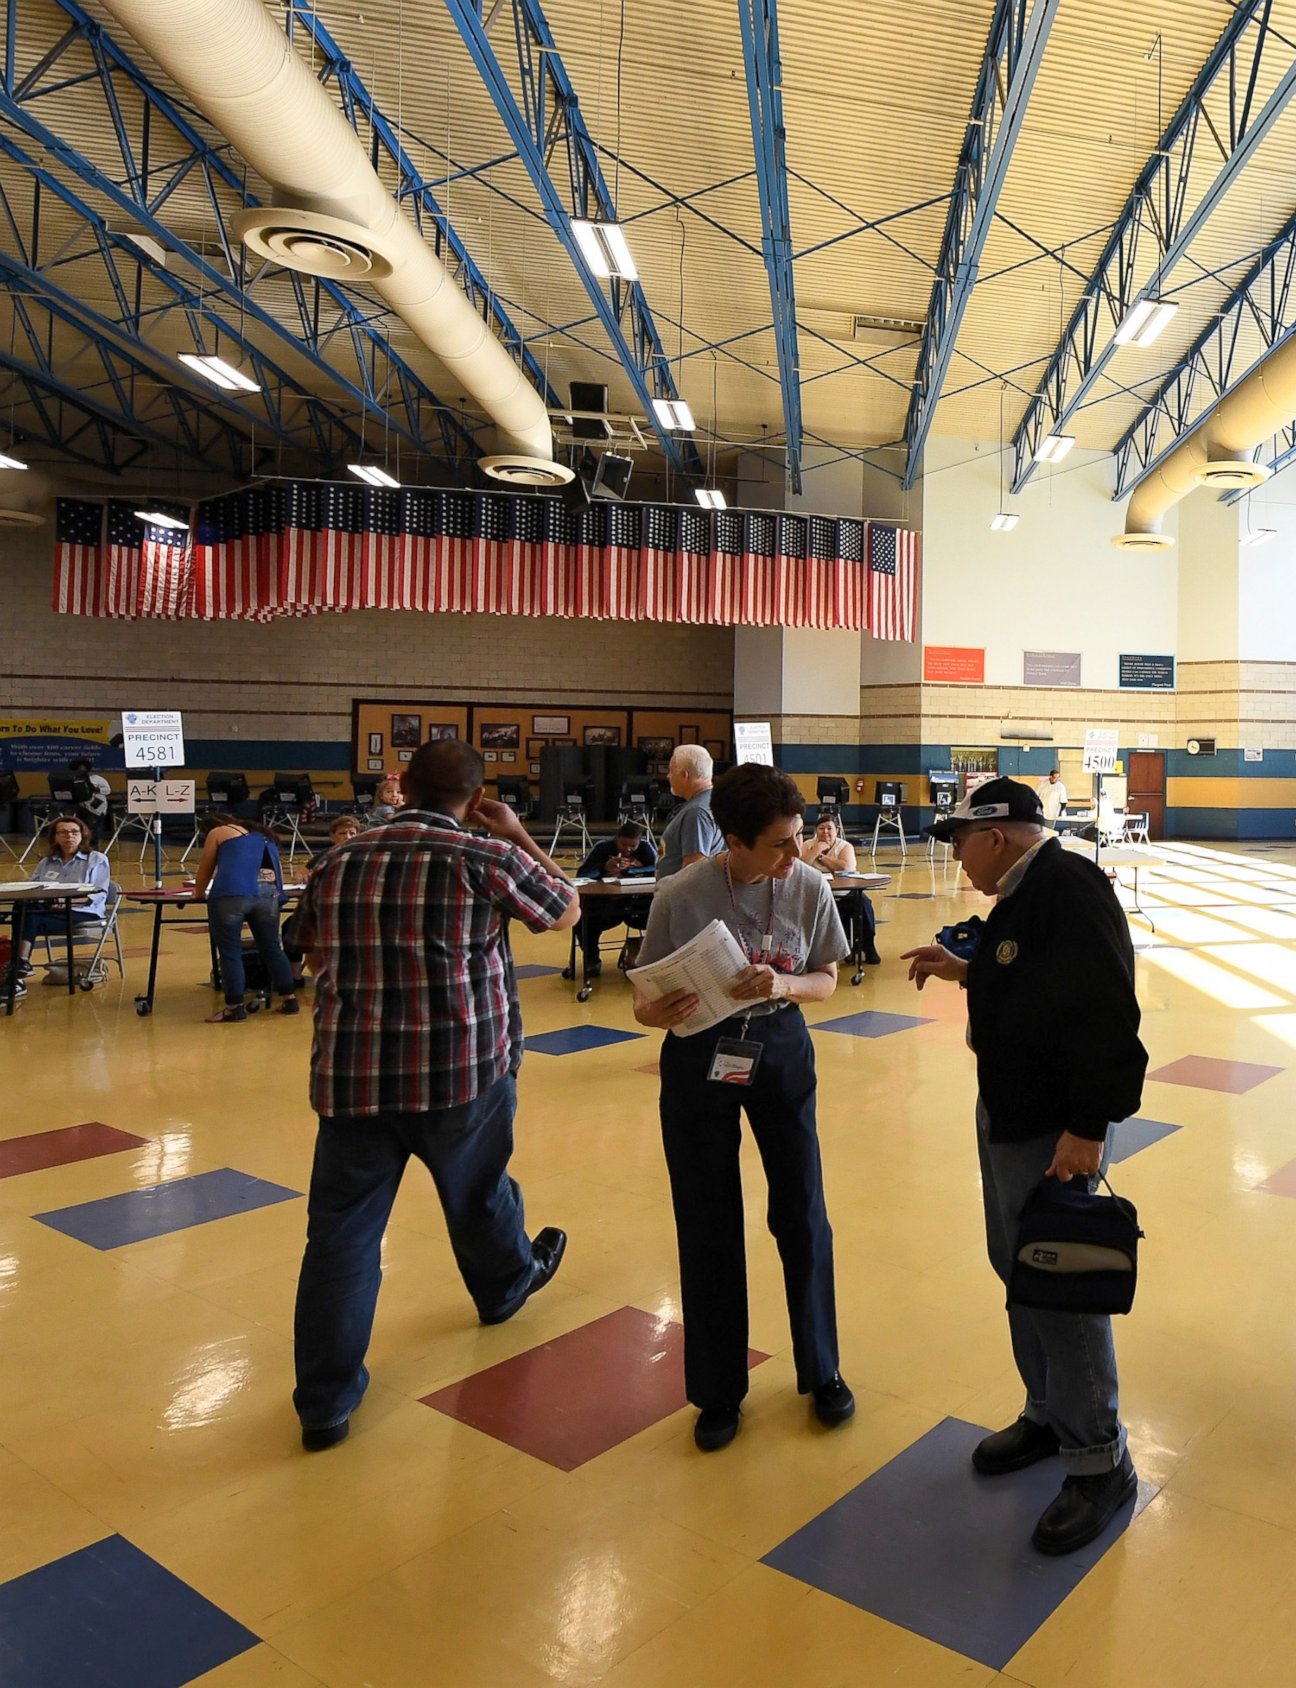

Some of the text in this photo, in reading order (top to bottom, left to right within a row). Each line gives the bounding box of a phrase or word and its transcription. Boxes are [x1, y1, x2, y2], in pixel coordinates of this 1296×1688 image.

[13, 725, 22, 733] To
[26, 725, 37, 733] Do
[39, 725, 60, 734] What
[63, 726, 79, 734] You
[128, 733, 180, 741] PRECINCT
[135, 746, 175, 761] 4581
[1084, 755, 1115, 769] 4500
[130, 785, 157, 796] A-K
[165, 785, 190, 796] L-Z
